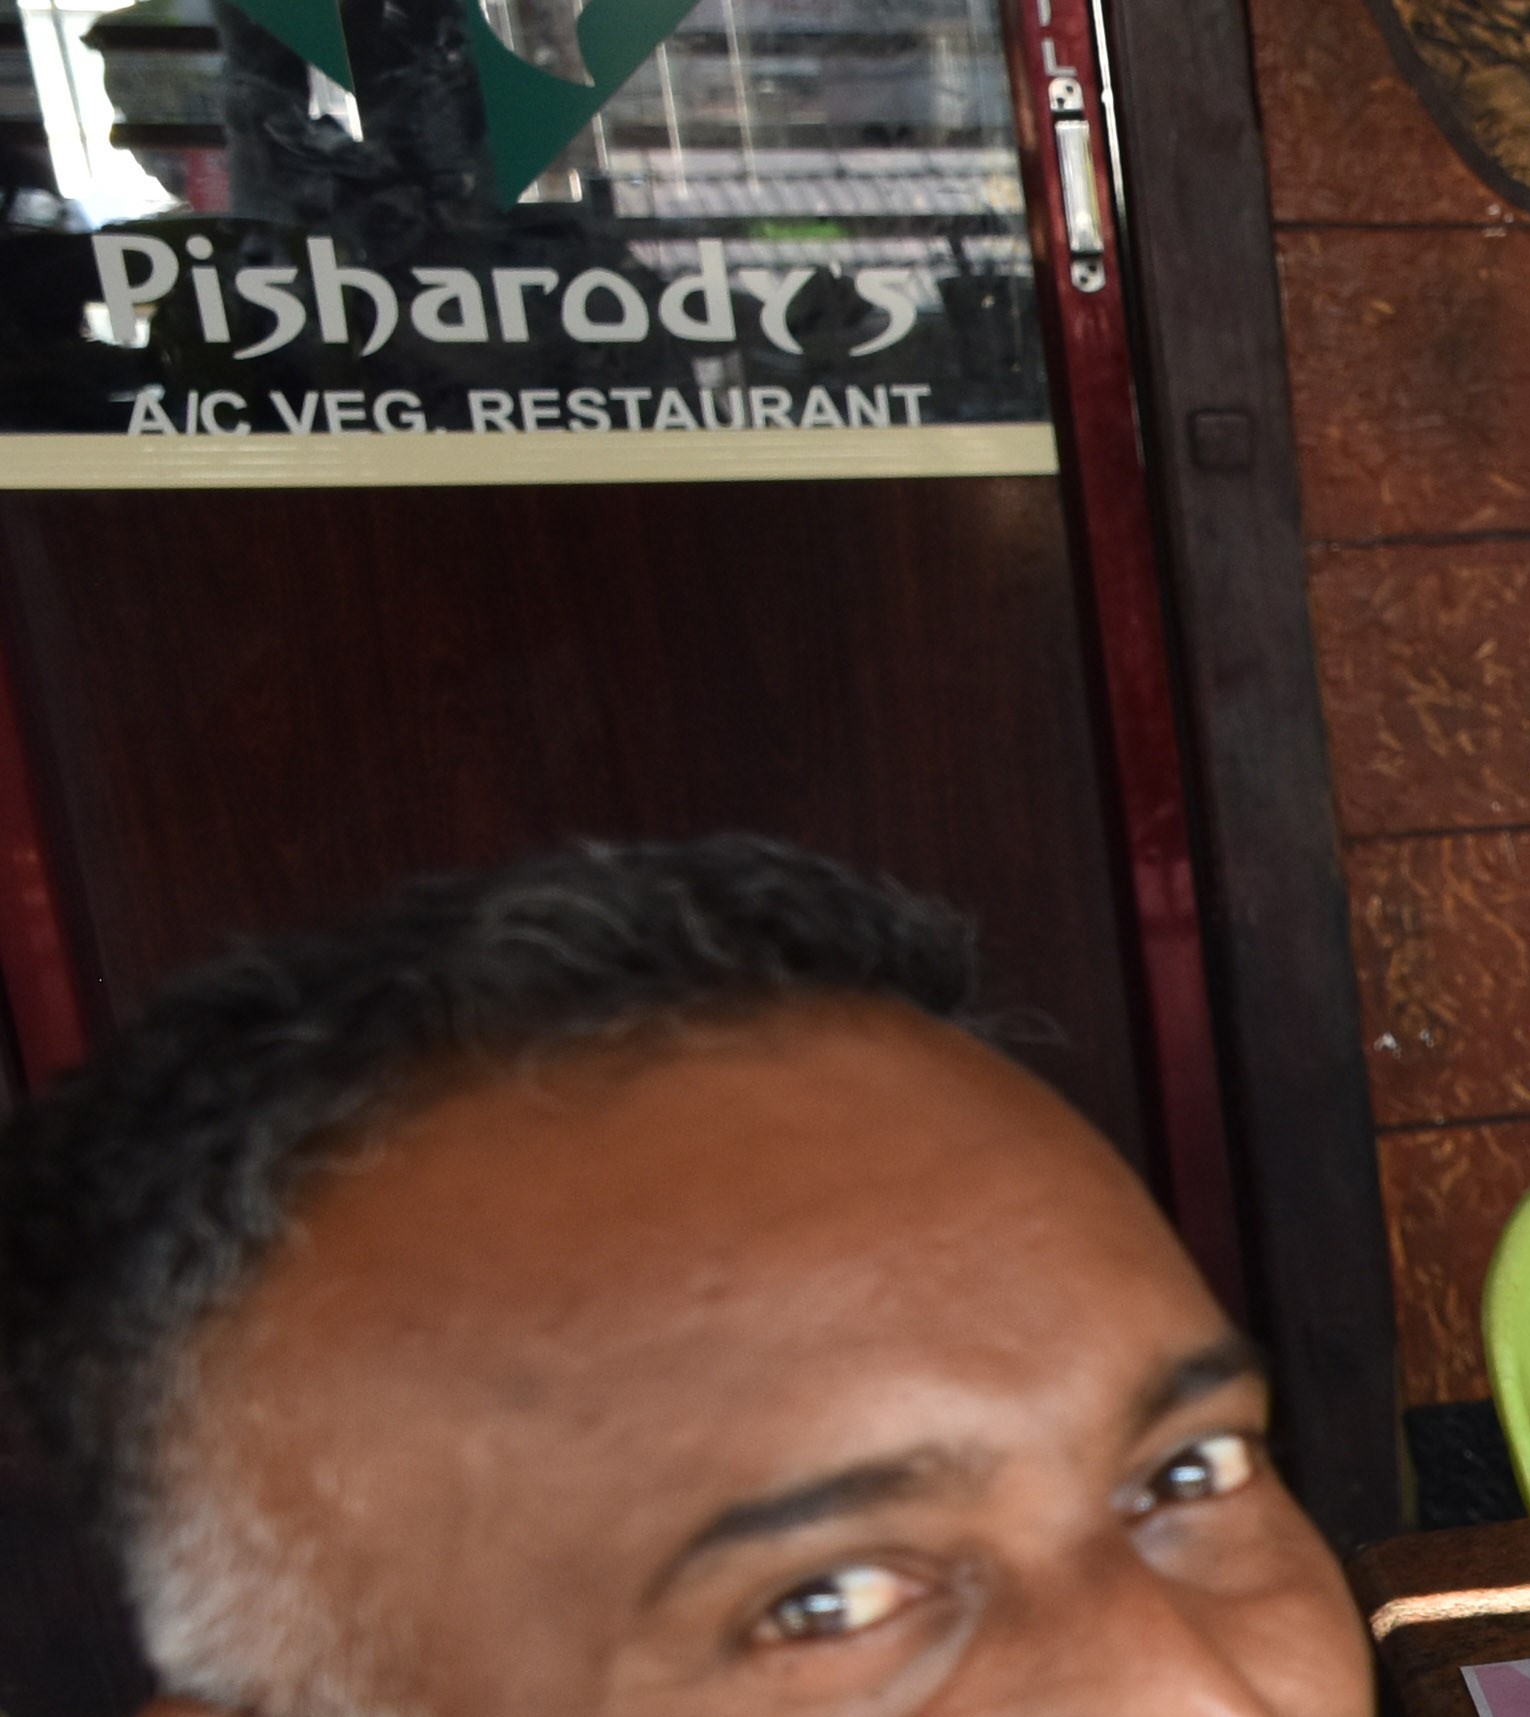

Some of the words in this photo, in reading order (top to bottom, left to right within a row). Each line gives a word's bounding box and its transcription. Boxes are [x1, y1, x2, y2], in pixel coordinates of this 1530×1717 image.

[93, 234, 917, 359] Pisharody's
[126, 392, 251, 436] A/C
[269, 391, 448, 434] VEG.
[468, 384, 933, 433] RESTAURANT
